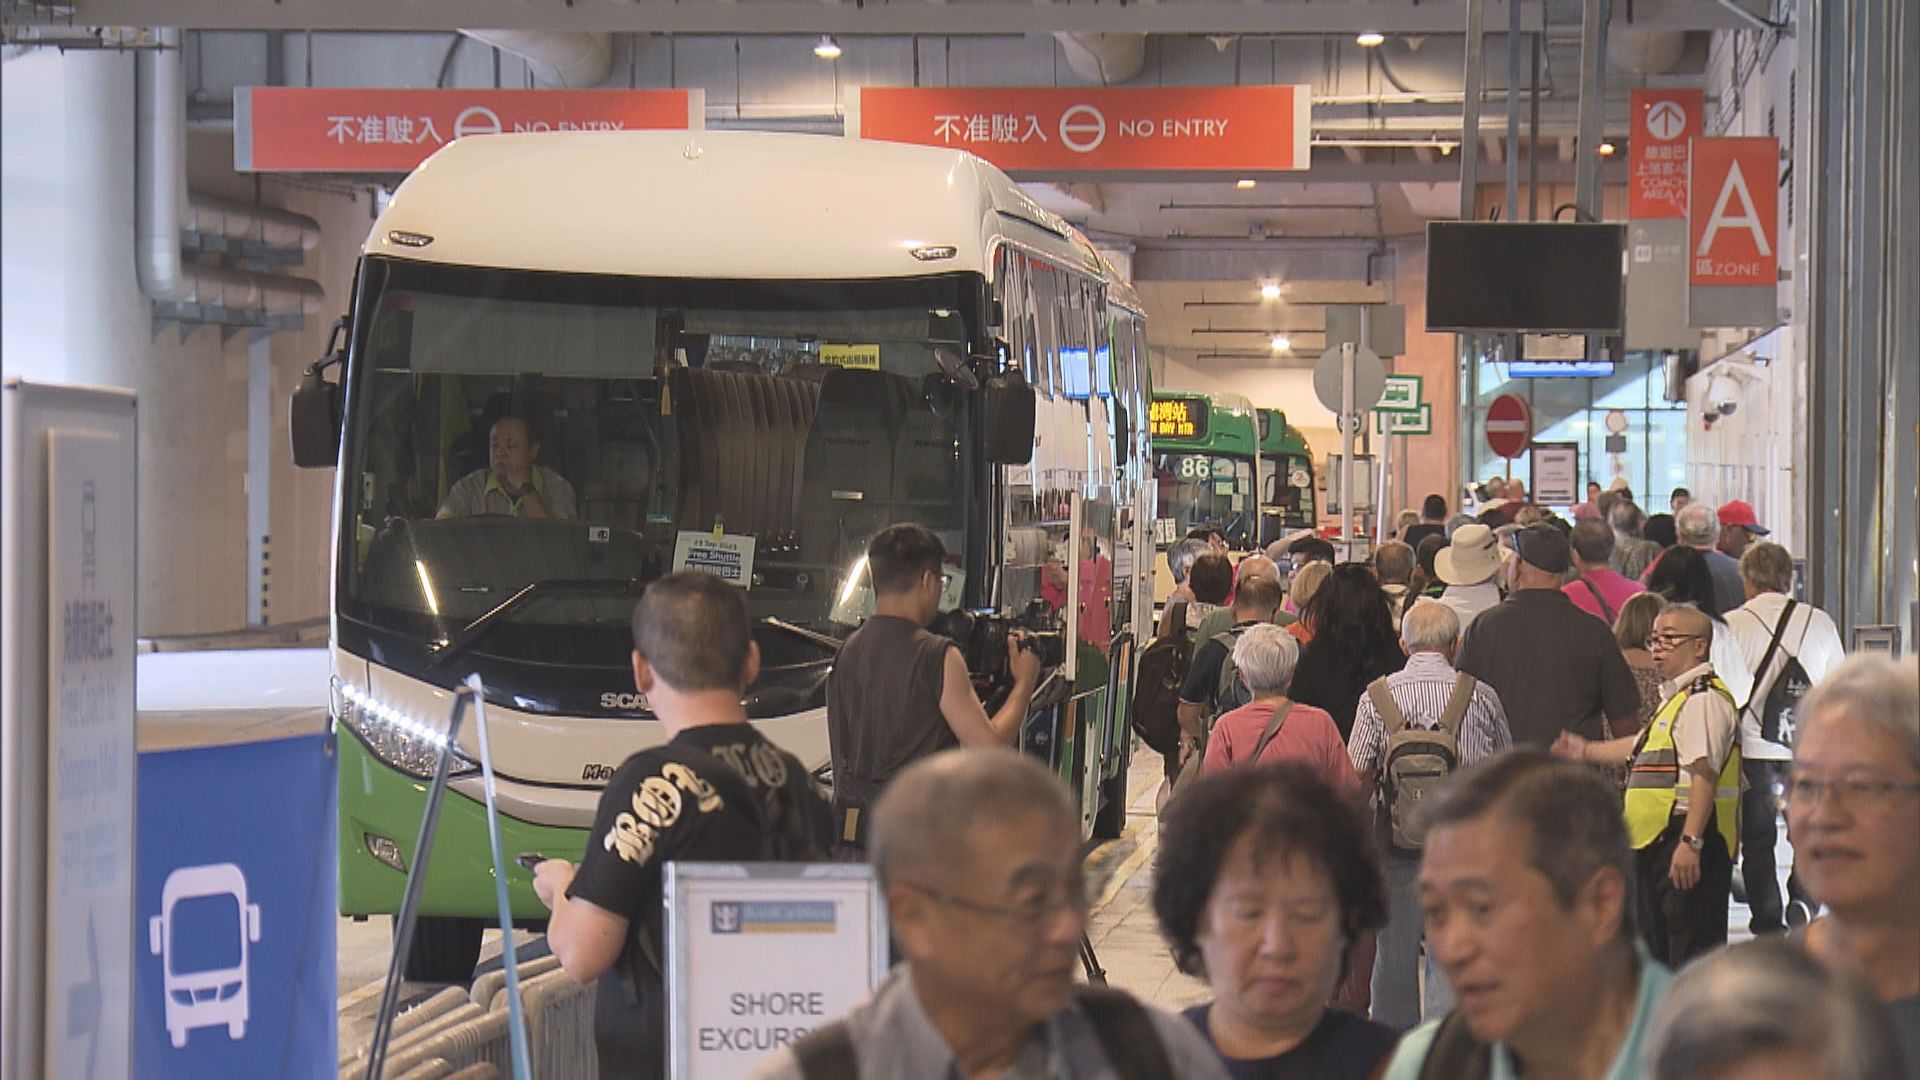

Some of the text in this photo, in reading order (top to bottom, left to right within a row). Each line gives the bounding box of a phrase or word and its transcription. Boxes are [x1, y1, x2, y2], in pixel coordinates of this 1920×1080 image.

[327, 115, 444, 144] 不准駛入
[933, 114, 1048, 144] 不准駛入
[1118, 119, 1228, 137] NO ENTRY
[1696, 157, 1772, 257] A
[1715, 262, 1760, 276] ZONE
[1160, 421, 1176, 435] BAY
[1178, 422, 1194, 436] MTR
[1181, 458, 1210, 478] 86
[688, 548, 741, 562] Free Shuttle
[582, 764, 615, 780] Ma
[730, 992, 824, 1015] SHORE
